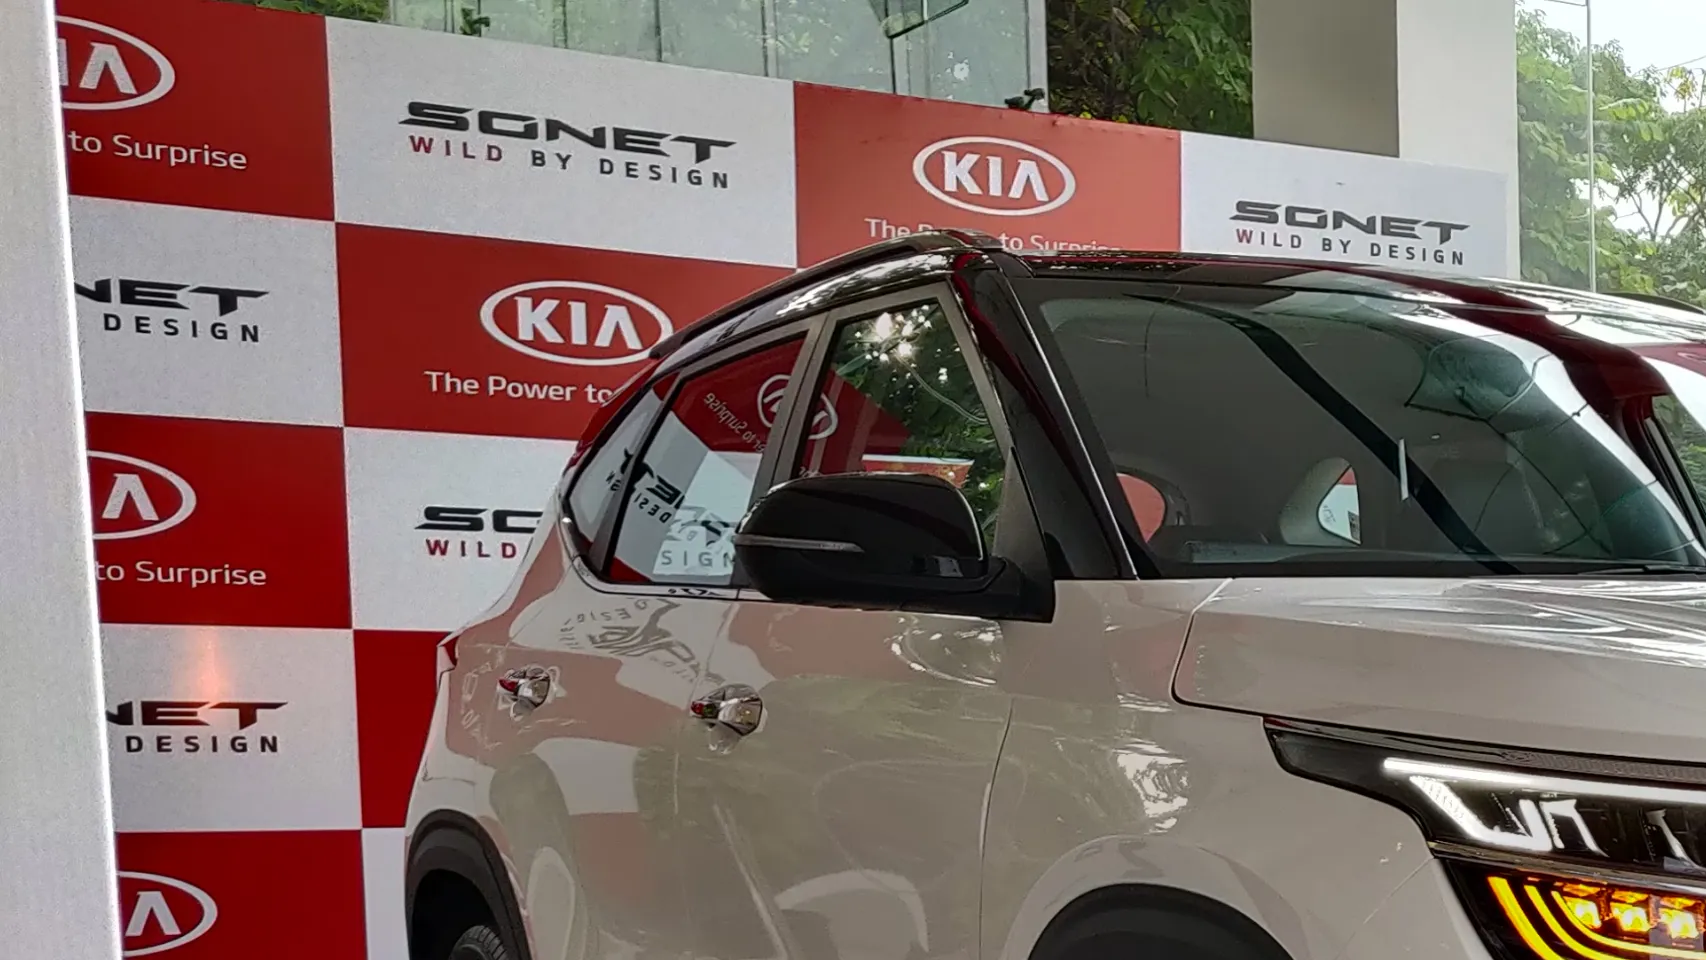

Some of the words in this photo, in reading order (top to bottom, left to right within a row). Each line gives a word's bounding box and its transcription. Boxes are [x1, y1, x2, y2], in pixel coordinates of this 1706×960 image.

[68, 130, 102, 154] to
[112, 133, 247, 170] Surprise
[398, 101, 737, 164] SONET
[408, 134, 503, 163] WILD
[531, 150, 572, 171] BY
[599, 157, 728, 189] DESIGN
[940, 150, 1051, 202] KIA
[864, 218, 911, 238] The
[1000, 232, 1023, 251] to
[1229, 200, 1470, 246] SONET
[1236, 228, 1303, 249] WILD
[1321, 238, 1352, 254] BY
[1370, 242, 1464, 266] DESIGN
[103, 312, 259, 342] DESIGN
[513, 296, 644, 350] KIA
[423, 370, 479, 395] The
[488, 374, 577, 401] Power
[584, 383, 615, 404] to
[425, 538, 517, 559] WILD
[135, 560, 267, 589] Surprise
[125, 735, 278, 753] DESIGN
